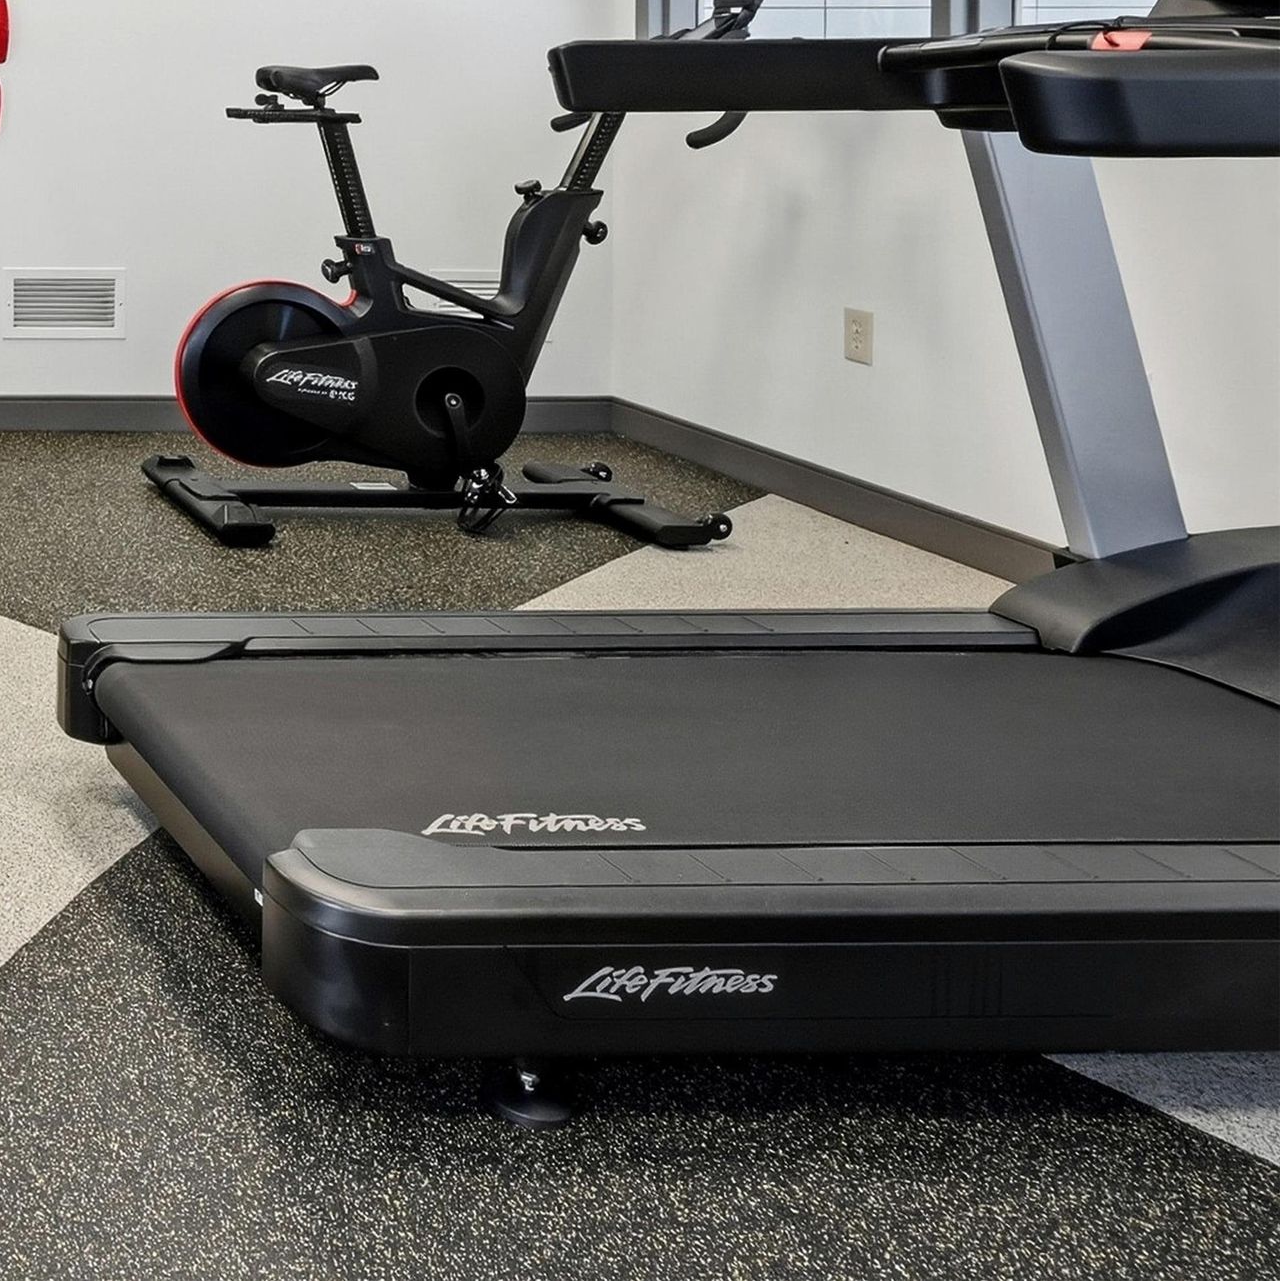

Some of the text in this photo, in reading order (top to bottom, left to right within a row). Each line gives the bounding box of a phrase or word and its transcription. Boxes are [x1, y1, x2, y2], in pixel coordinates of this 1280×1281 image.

[421, 812, 647, 836] Life Fitness
[563, 966, 778, 1003] Life Fitness
